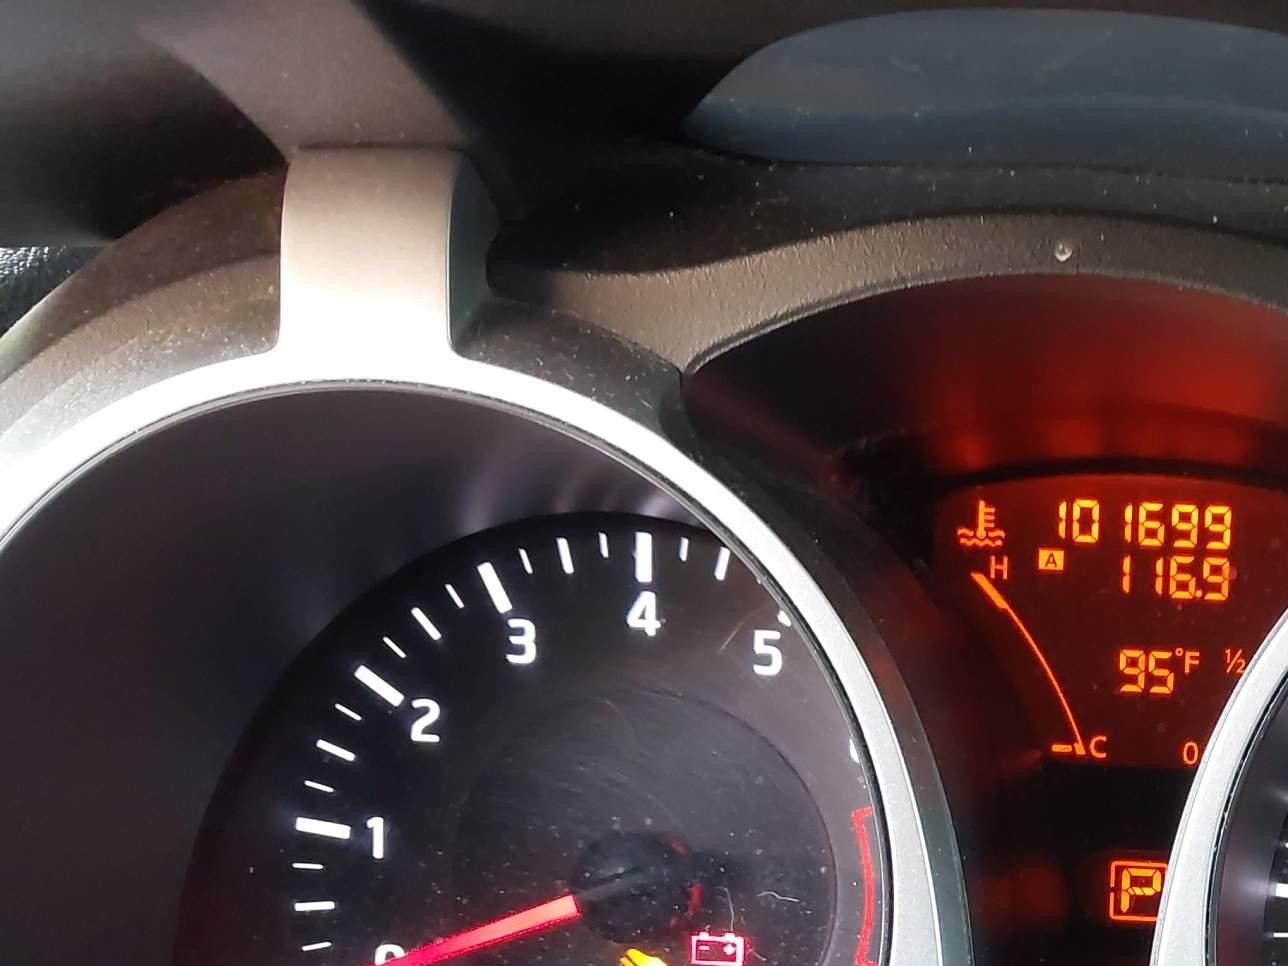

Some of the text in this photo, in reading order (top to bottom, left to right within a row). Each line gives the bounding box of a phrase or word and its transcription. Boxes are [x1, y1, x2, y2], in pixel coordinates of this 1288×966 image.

[1058, 498, 1231, 549] 101699
[990, 556, 1008, 580] H
[1042, 551, 1061, 569] A
[1122, 555, 1229, 601] 116.9
[627, 591, 660, 636] 4
[505, 619, 537, 664] 3
[752, 629, 783, 676] 5
[410, 699, 440, 742] 2
[1091, 736, 1107, 759] C
[366, 817, 385, 859] 1
[1121, 868, 1161, 913] P
